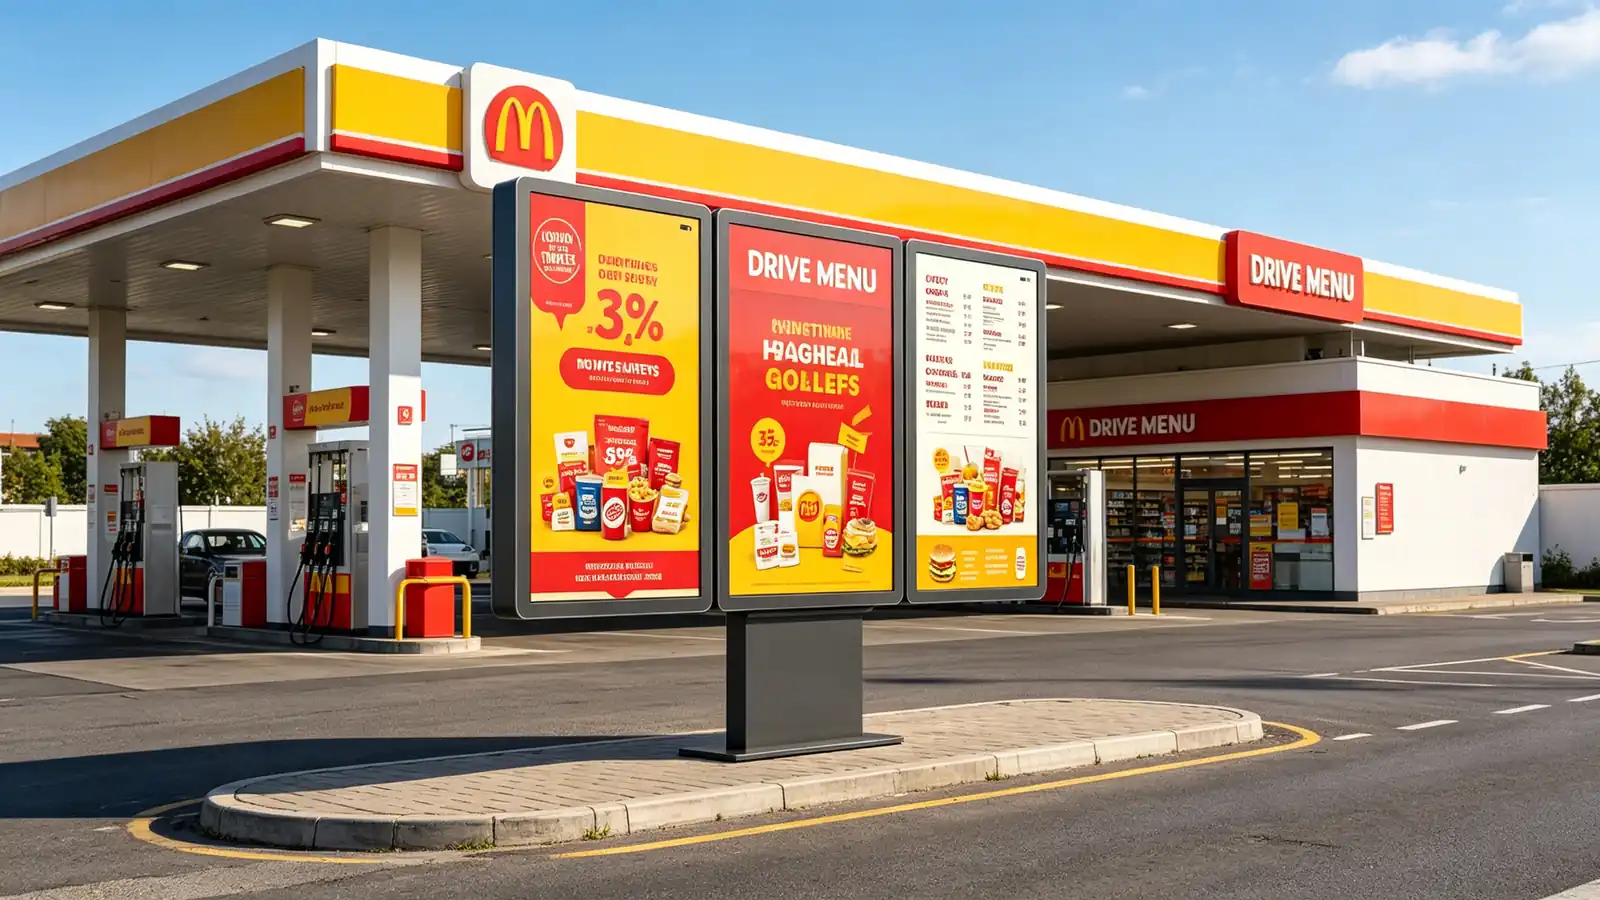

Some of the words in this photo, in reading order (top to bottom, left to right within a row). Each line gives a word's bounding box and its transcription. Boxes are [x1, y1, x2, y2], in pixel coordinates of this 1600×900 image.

[495, 96, 554, 160] M
[748, 249, 811, 284] DRIVE
[817, 260, 877, 293] MENU
[1250, 253, 1303, 292] DRIVE
[1305, 264, 1355, 302] MENU
[1060, 416, 1085, 442] M
[1089, 417, 1138, 437] DRIVE
[1141, 413, 1196, 435] MENU
